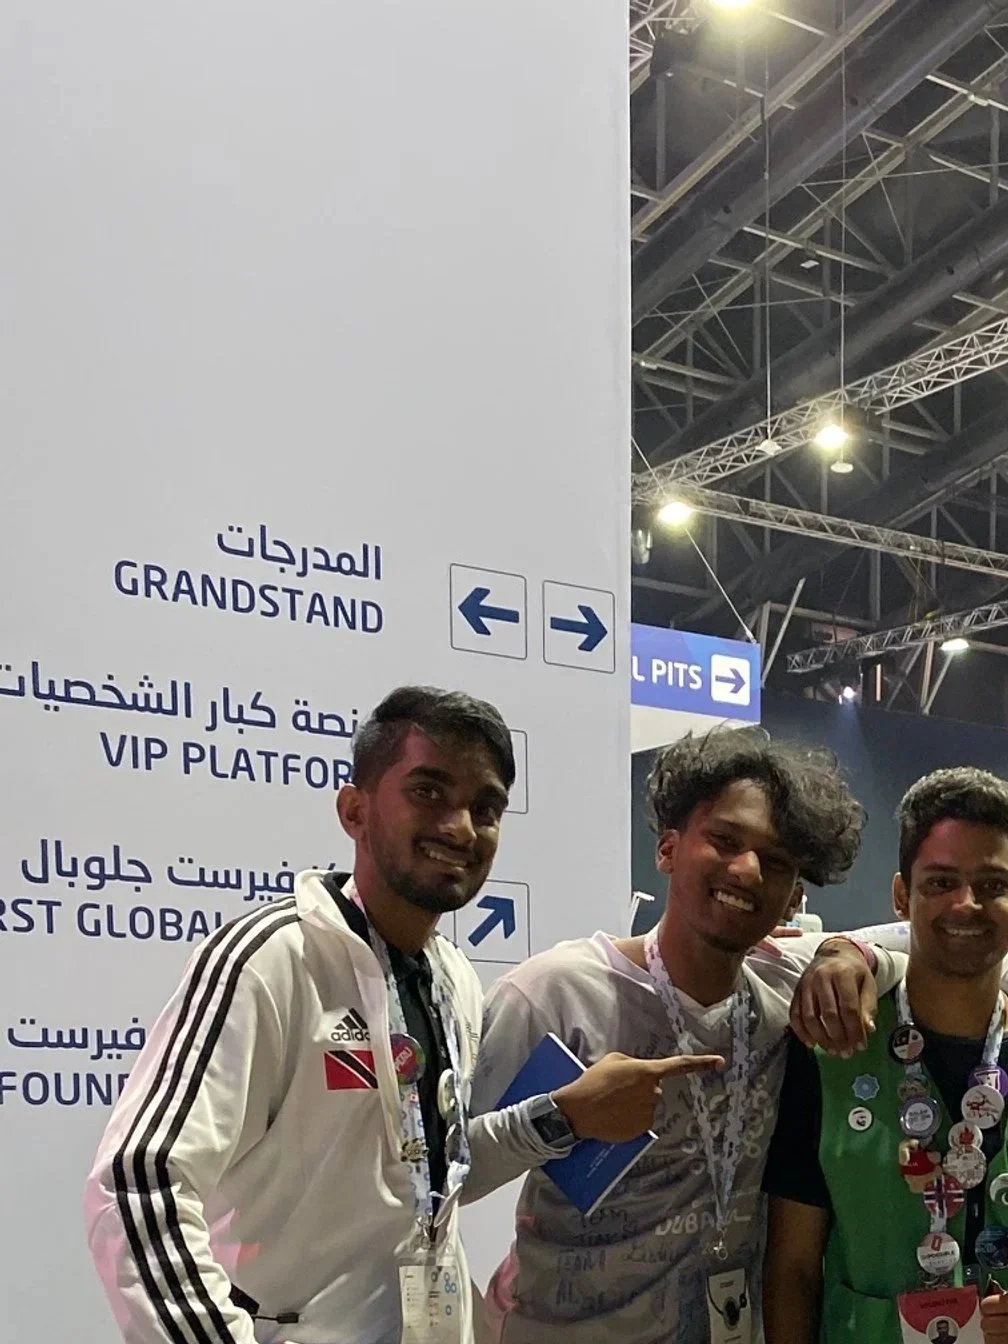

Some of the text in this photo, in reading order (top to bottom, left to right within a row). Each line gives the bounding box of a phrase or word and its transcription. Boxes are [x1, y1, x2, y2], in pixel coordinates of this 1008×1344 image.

[217, 524, 382, 580] المدرجات
[114, 560, 383, 634] GRANDSTAND
[632, 655, 702, 690] L PITS
[205, 686, 276, 735] كبار
[100, 732, 354, 791] VIP PLATFOR
[21, 839, 152, 892] جلوبال
[7, 1016, 147, 1060] فيرست
[656, 1211, 715, 1236] DUBA
